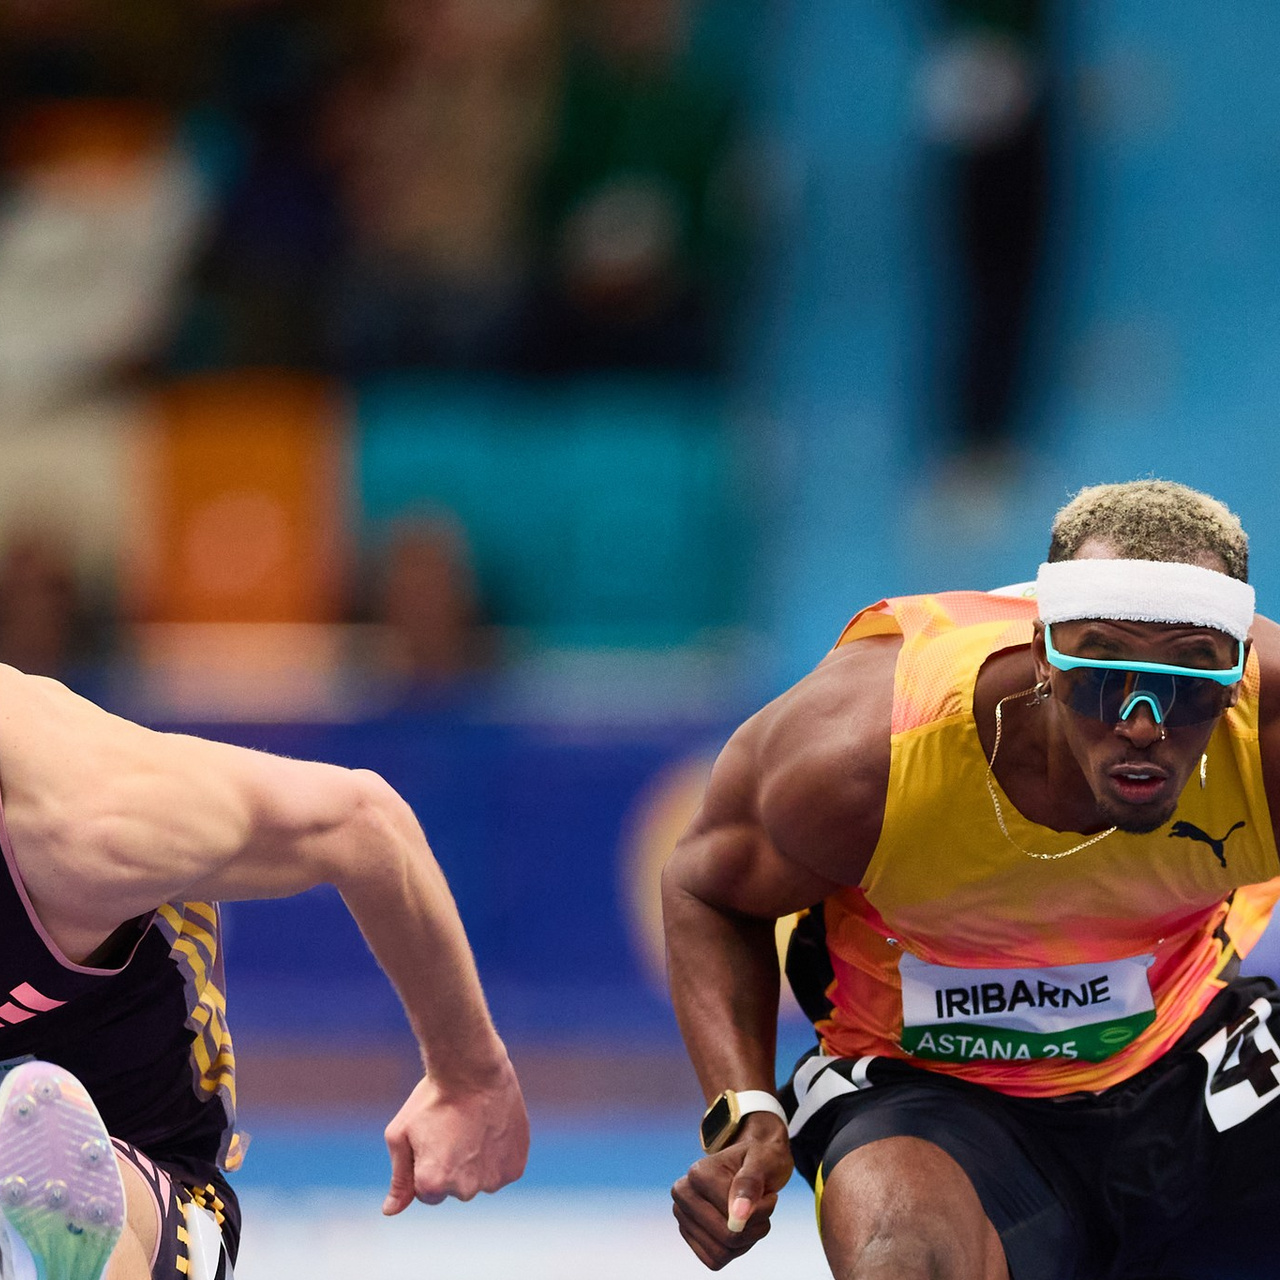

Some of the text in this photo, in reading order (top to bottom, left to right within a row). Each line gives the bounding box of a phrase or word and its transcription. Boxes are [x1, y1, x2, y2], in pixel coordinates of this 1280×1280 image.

[935, 975, 1111, 1019] IRIBARNE
[917, 1032, 1079, 1060] ASTANA 25
[1209, 1008, 1280, 1098] 4
